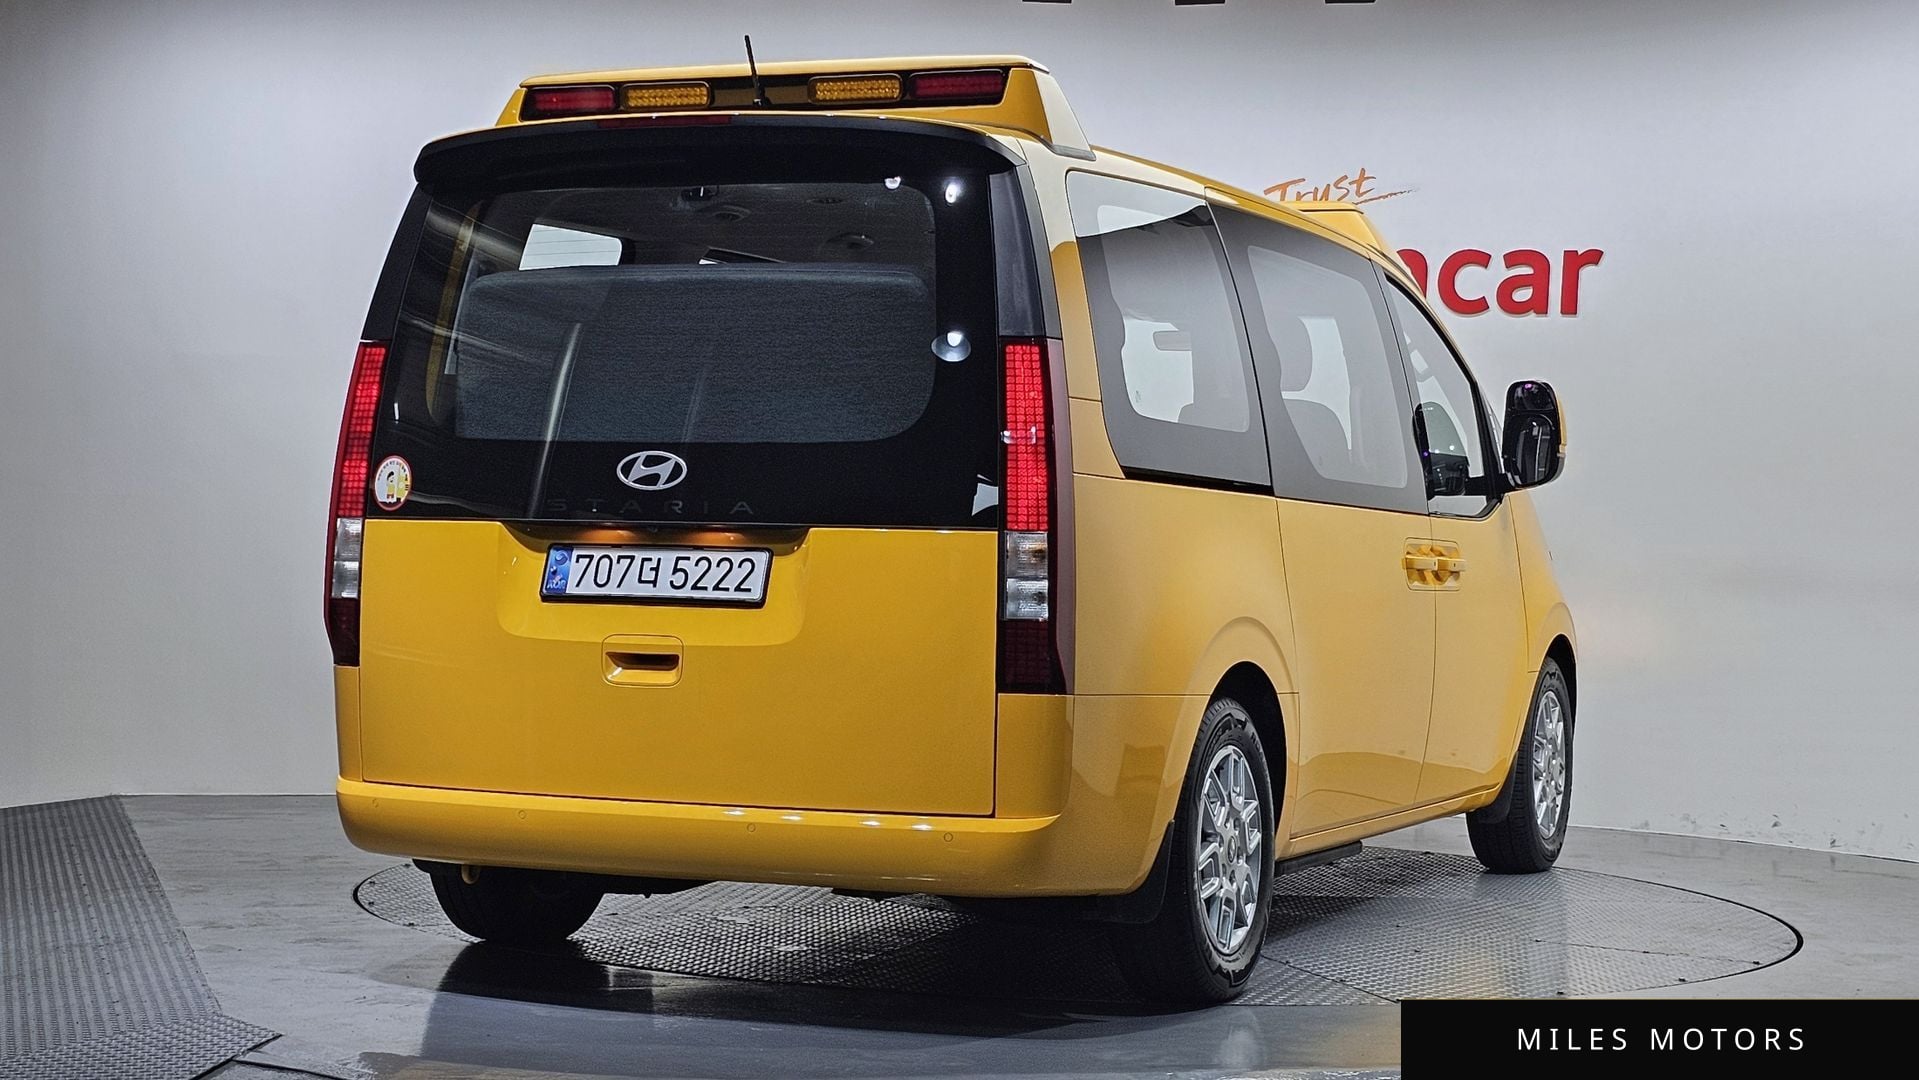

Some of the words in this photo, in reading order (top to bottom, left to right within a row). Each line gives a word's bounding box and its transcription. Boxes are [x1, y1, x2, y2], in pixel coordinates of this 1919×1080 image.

[1263, 167, 1377, 202] Trust
[547, 498, 754, 515] STARIA
[574, 554, 661, 588] 707더
[669, 556, 757, 592] 5222
